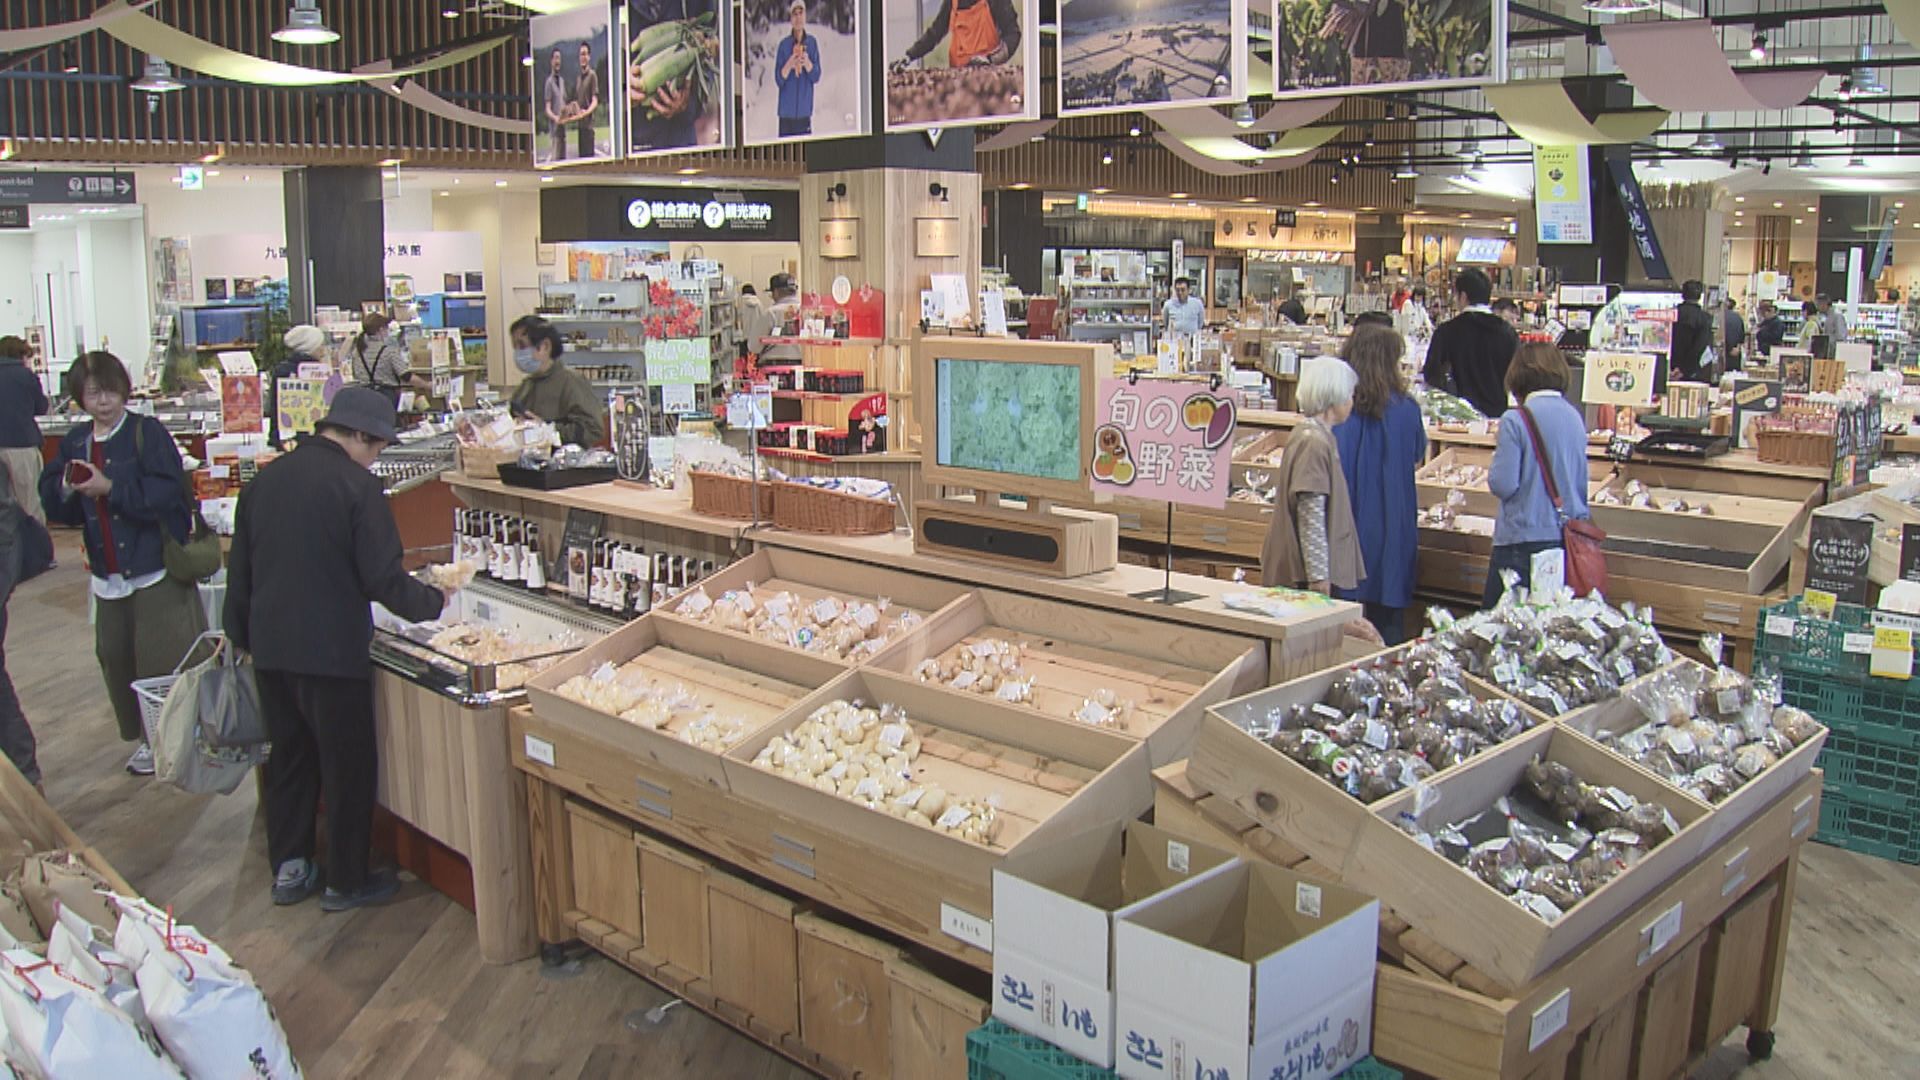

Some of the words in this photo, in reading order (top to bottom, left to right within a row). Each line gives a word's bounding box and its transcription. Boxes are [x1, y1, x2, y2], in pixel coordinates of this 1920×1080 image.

[651, 201, 701, 218] 総合案内
[725, 203, 772, 220] 観光案内
[1597, 360, 1647, 370] しいたけ
[1108, 388, 1179, 438] 旬の
[1137, 441, 1217, 491] 野菜
